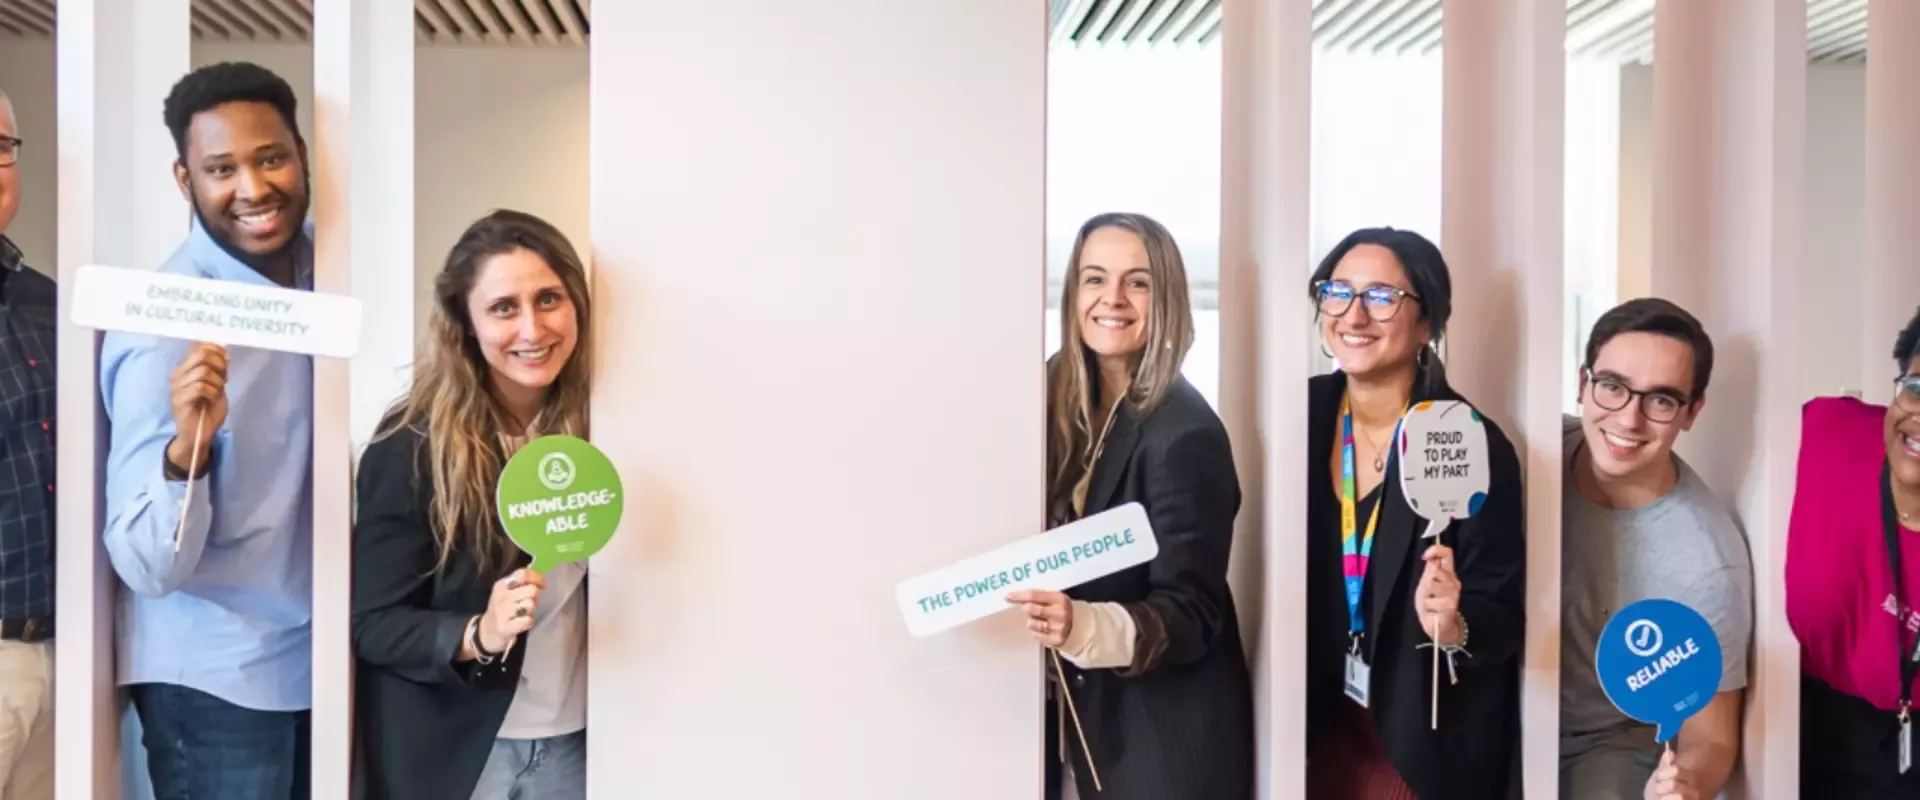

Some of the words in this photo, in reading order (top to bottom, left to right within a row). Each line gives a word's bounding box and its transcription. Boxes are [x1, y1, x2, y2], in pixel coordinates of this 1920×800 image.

[146, 284, 241, 308] EMBRACING
[243, 297, 293, 314] UNITY
[125, 302, 142, 317] IN
[145, 304, 225, 327] CULTURAL
[229, 314, 310, 336] DIVERSITY
[1426, 431, 1463, 445] PROUD
[1424, 448, 1439, 462] TO
[1441, 448, 1468, 462] PLAY
[1424, 465, 1440, 479] MY
[1442, 464, 1470, 478] PART
[508, 488, 616, 520] KNOWLEDGE-
[545, 512, 588, 535] ABLE
[917, 590, 952, 613] THE
[954, 571, 1010, 603] POWER
[1012, 562, 1034, 583] OF
[1036, 550, 1070, 575] OUR
[1071, 528, 1135, 562] PEOPLE
[1626, 637, 1700, 692] RELIABLE
